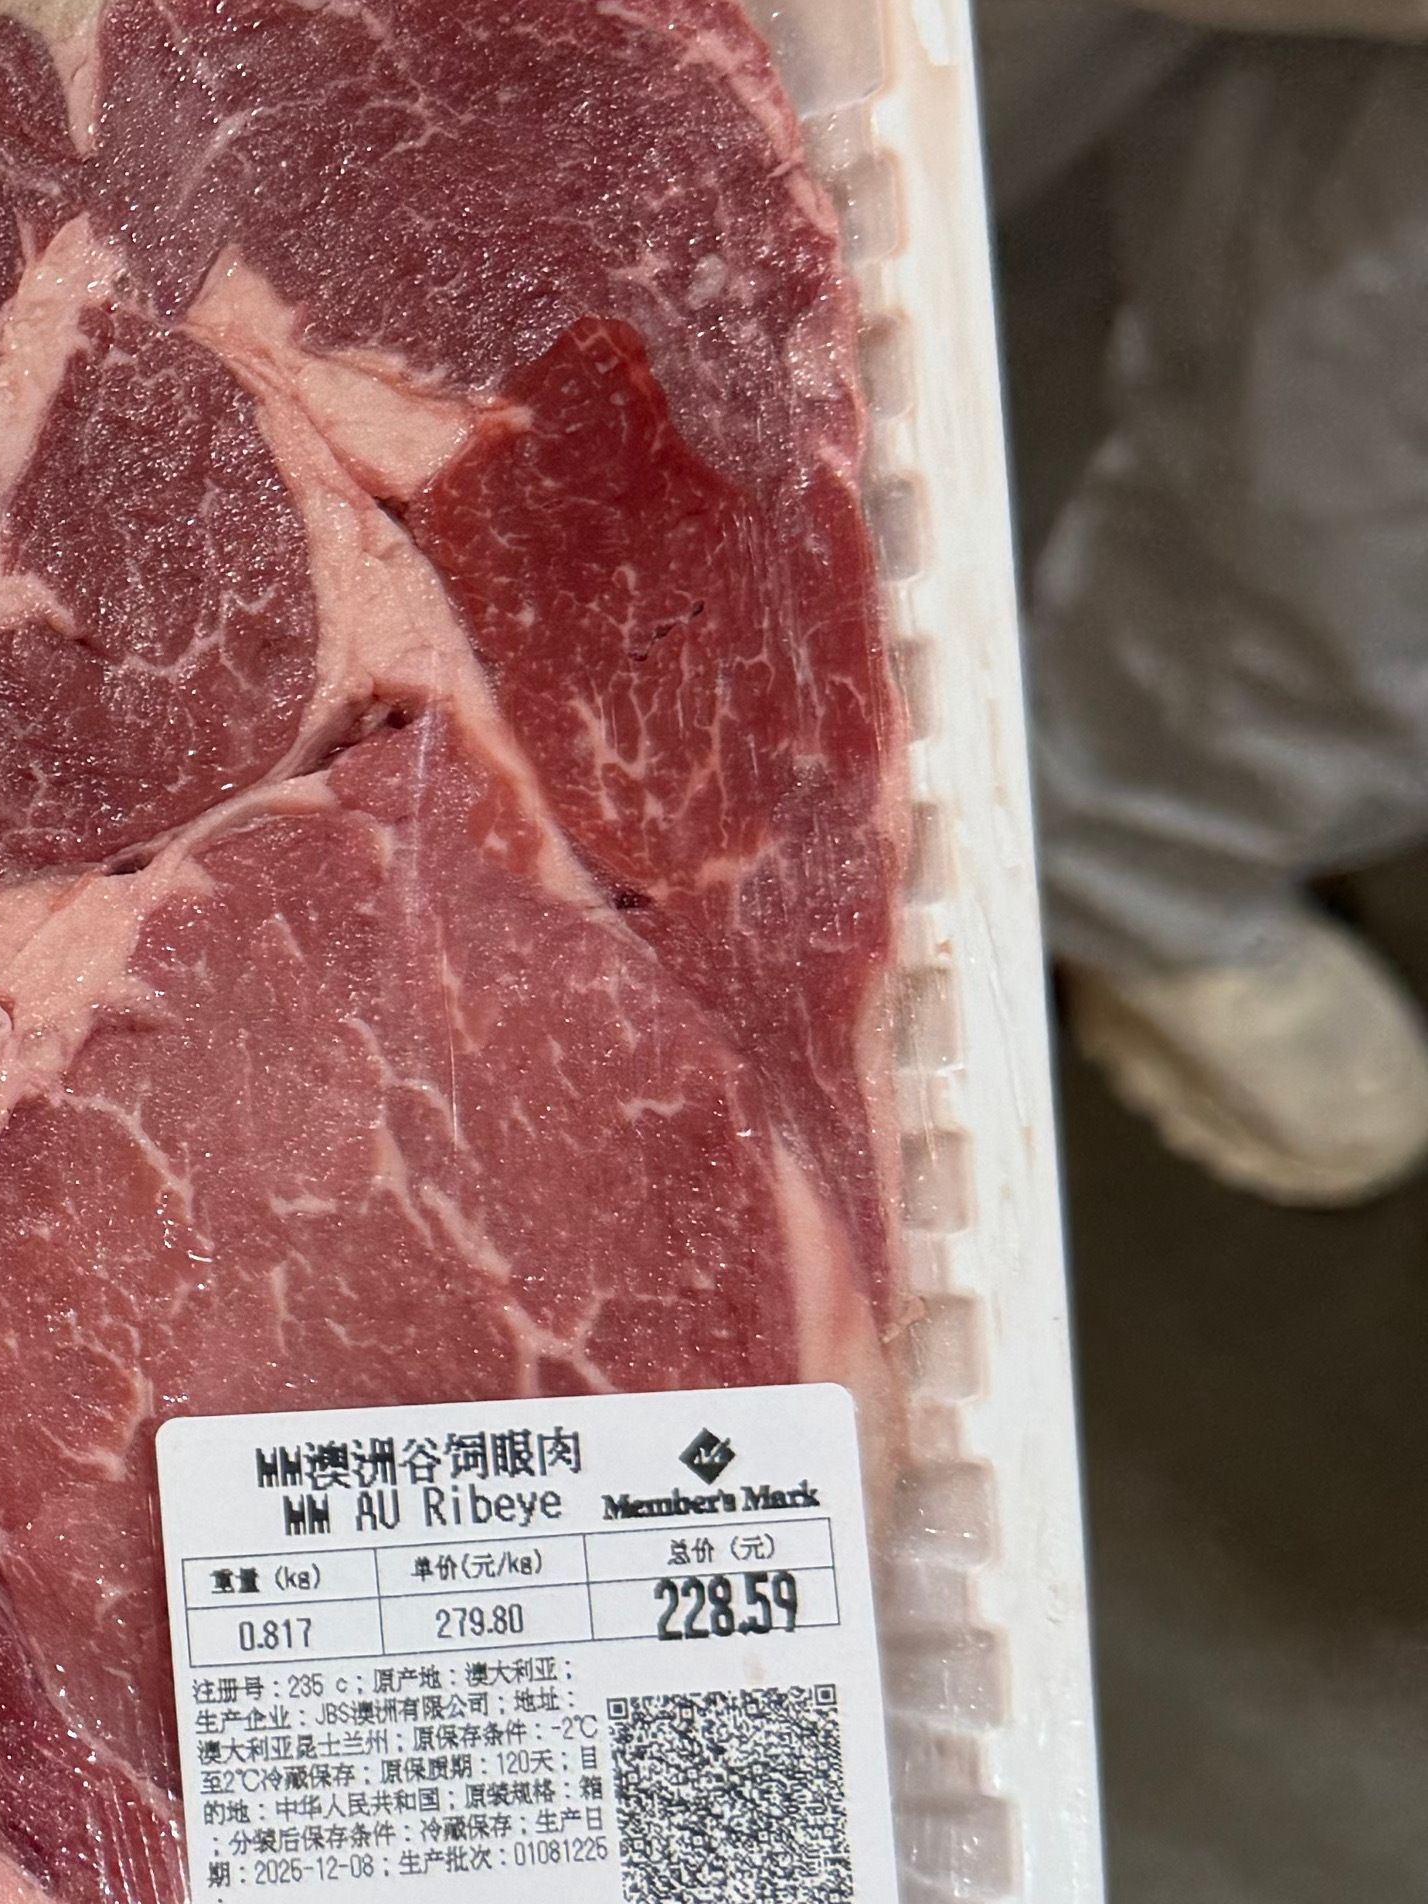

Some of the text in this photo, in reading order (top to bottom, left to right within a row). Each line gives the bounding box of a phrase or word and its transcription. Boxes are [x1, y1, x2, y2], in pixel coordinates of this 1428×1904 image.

[354, 1487, 402, 1532] AU
[422, 1482, 563, 1528] Ribeye
[741, 1477, 822, 1512] Mark
[434, 1602, 525, 1640] 279.80
[652, 1568, 799, 1643] 228.59
[237, 1616, 314, 1653] 0.817
